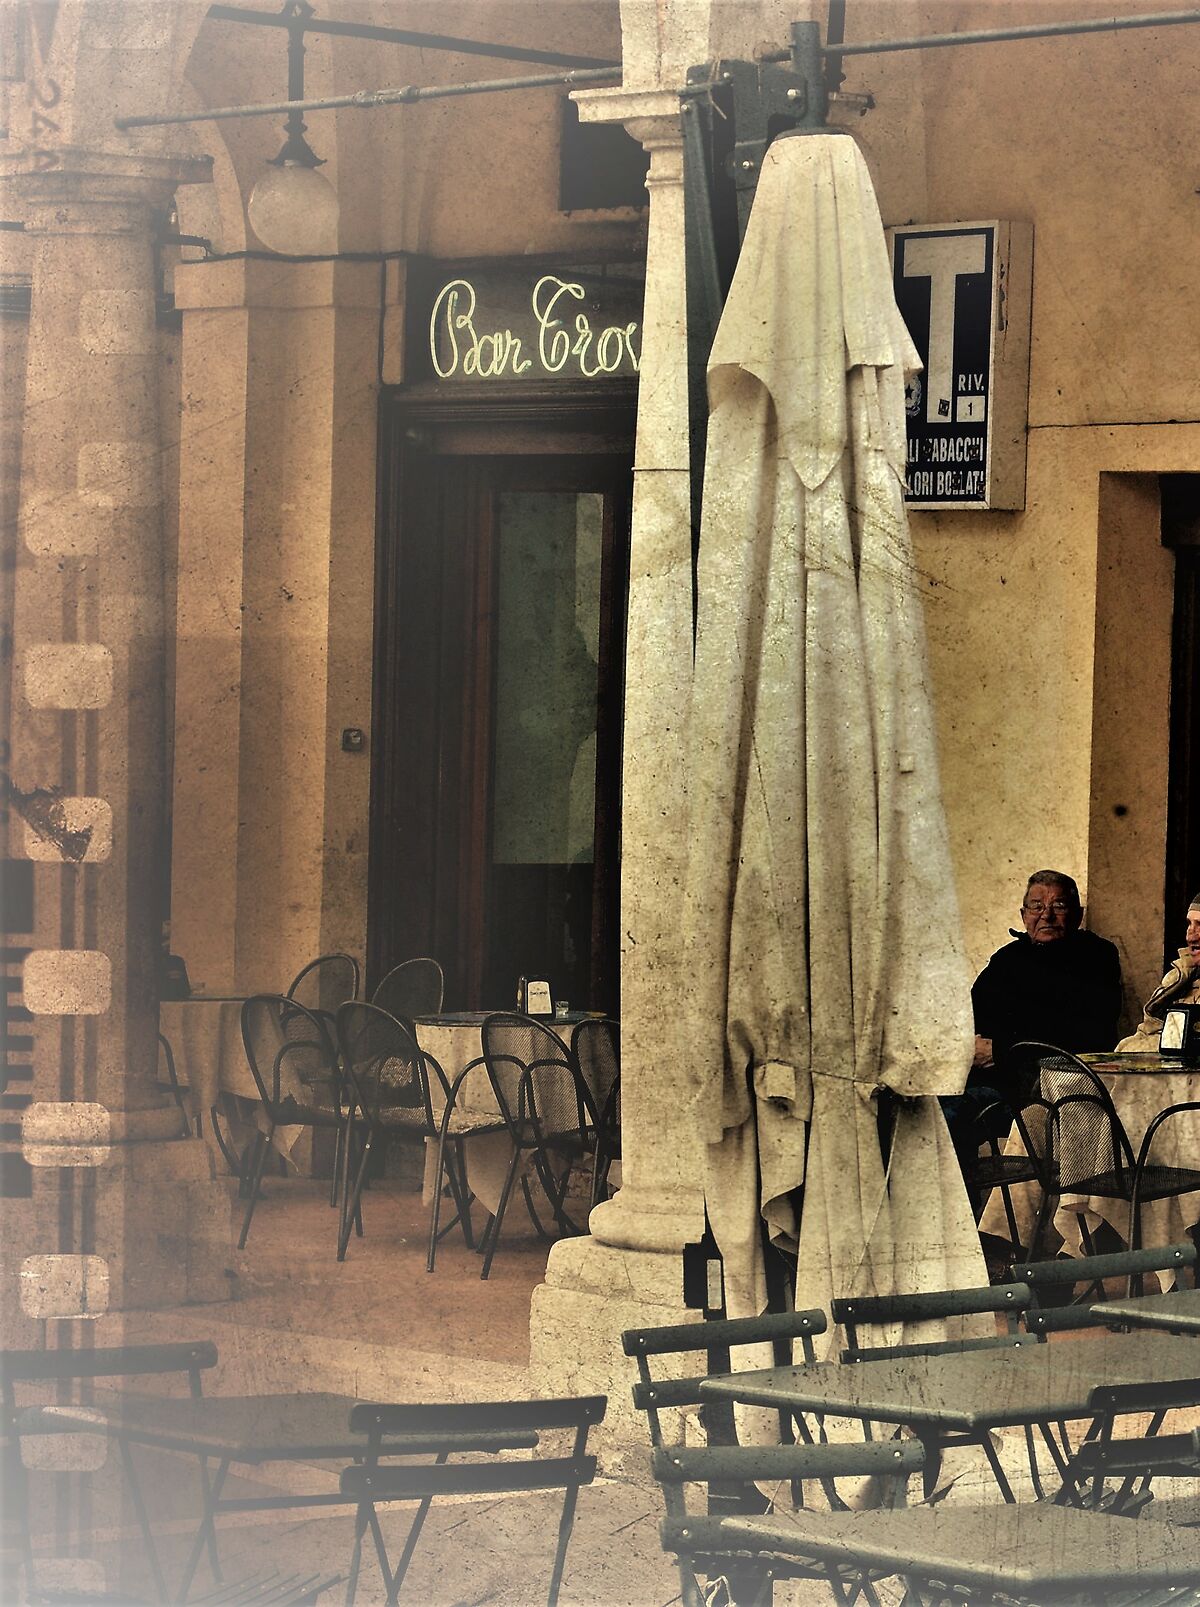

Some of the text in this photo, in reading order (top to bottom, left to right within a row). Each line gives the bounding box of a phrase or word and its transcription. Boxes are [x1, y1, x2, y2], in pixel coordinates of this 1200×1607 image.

[430, 279, 532, 378] Bar
[903, 234, 987, 423] T
[958, 373, 985, 392] RIV.
[967, 402, 973, 416] 1
[922, 437, 984, 462] ABACCI
[905, 471, 933, 496] LORI
